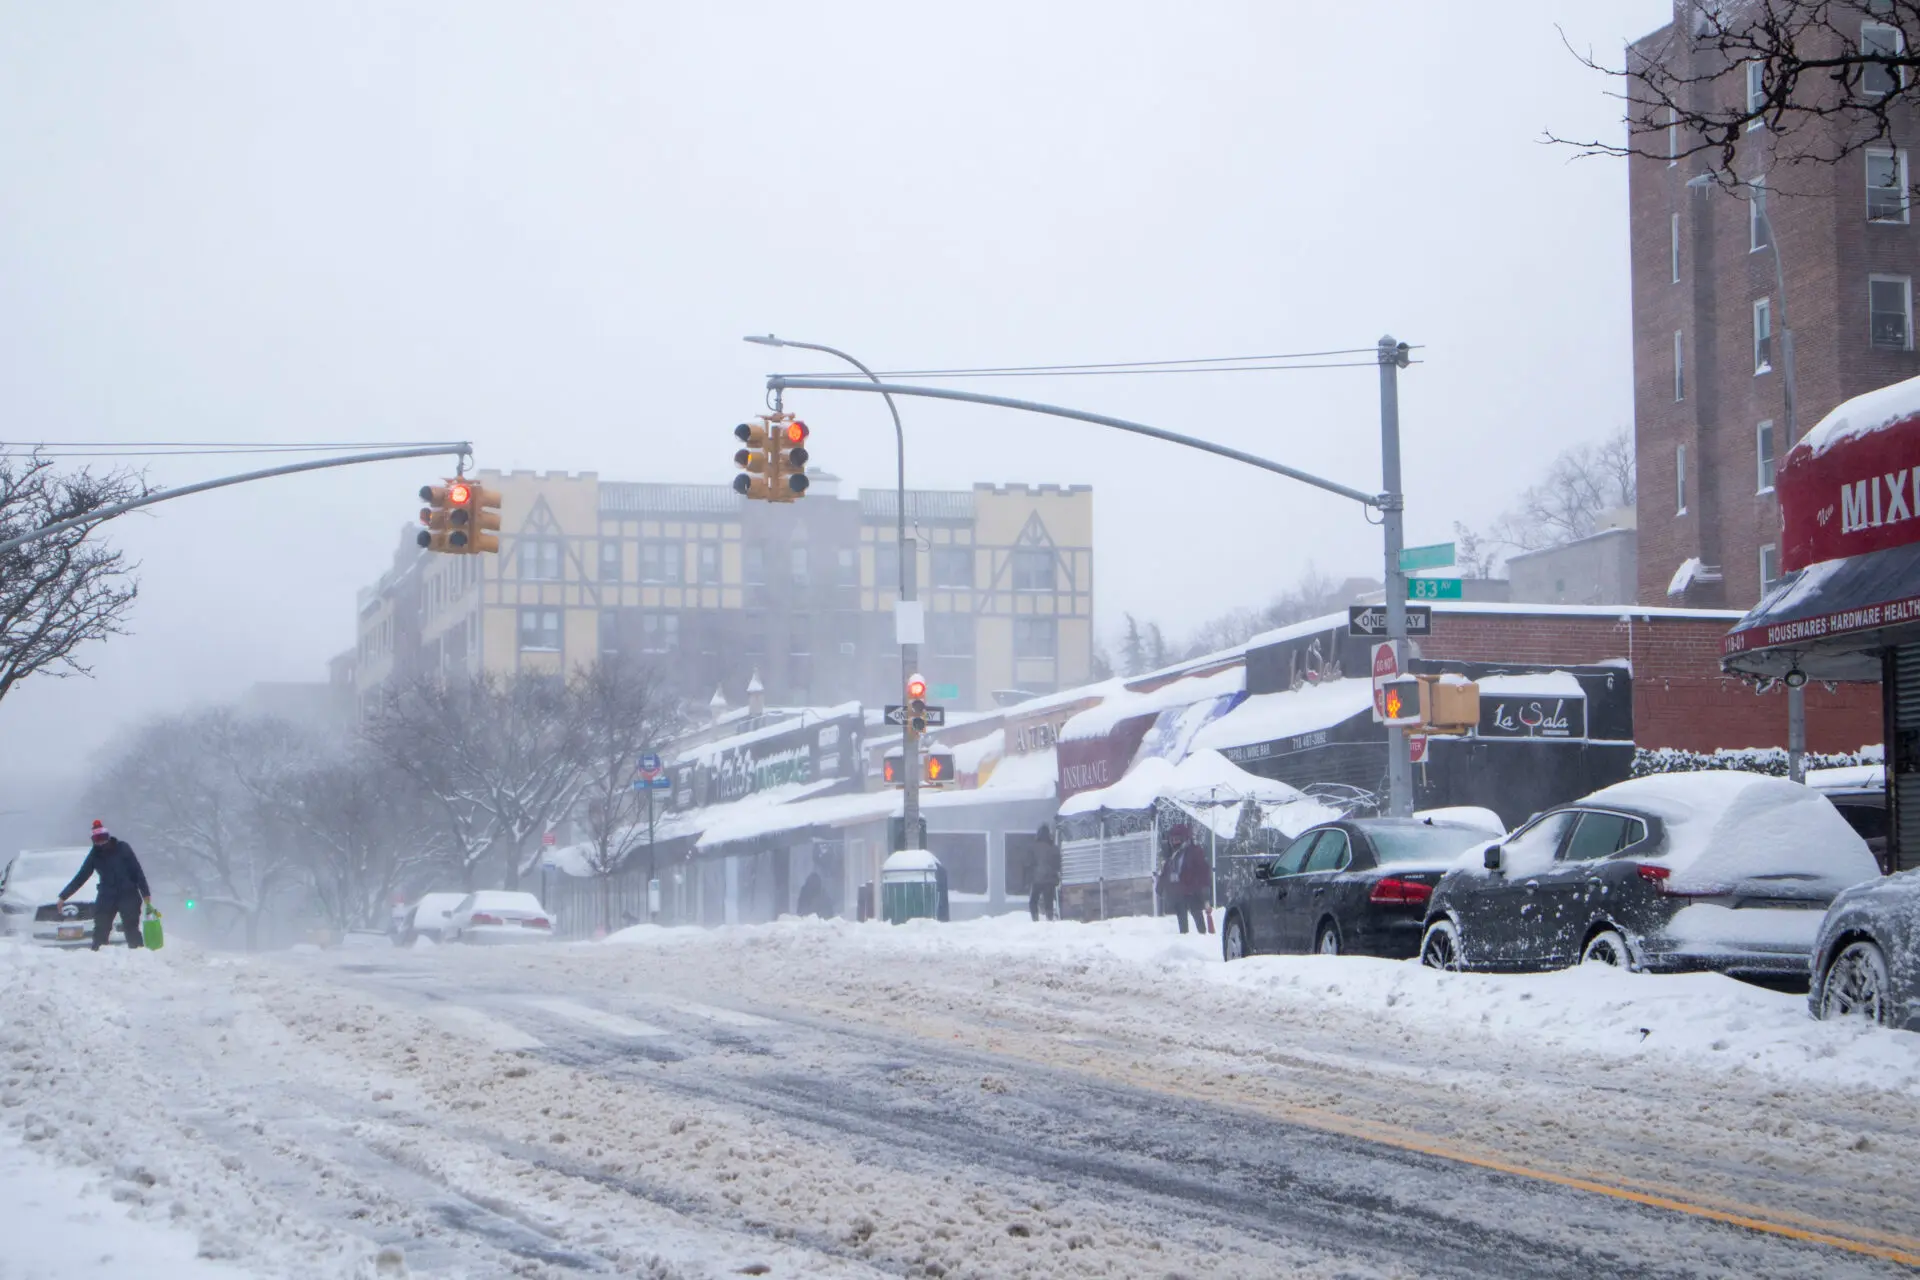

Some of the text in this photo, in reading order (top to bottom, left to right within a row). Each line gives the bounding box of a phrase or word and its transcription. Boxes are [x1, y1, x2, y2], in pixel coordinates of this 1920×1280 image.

[1817, 503, 1834, 527] New
[1415, 580, 1452, 597] 83 AV
[1362, 615, 1421, 627] ONE AY
[1768, 617, 1827, 643] HOUSEWARES
[1830, 607, 1881, 632] HARDWARE
[1376, 659, 1384, 672] DO
[1494, 698, 1569, 731] La Sala
[1063, 759, 1109, 789] INSURANCE
